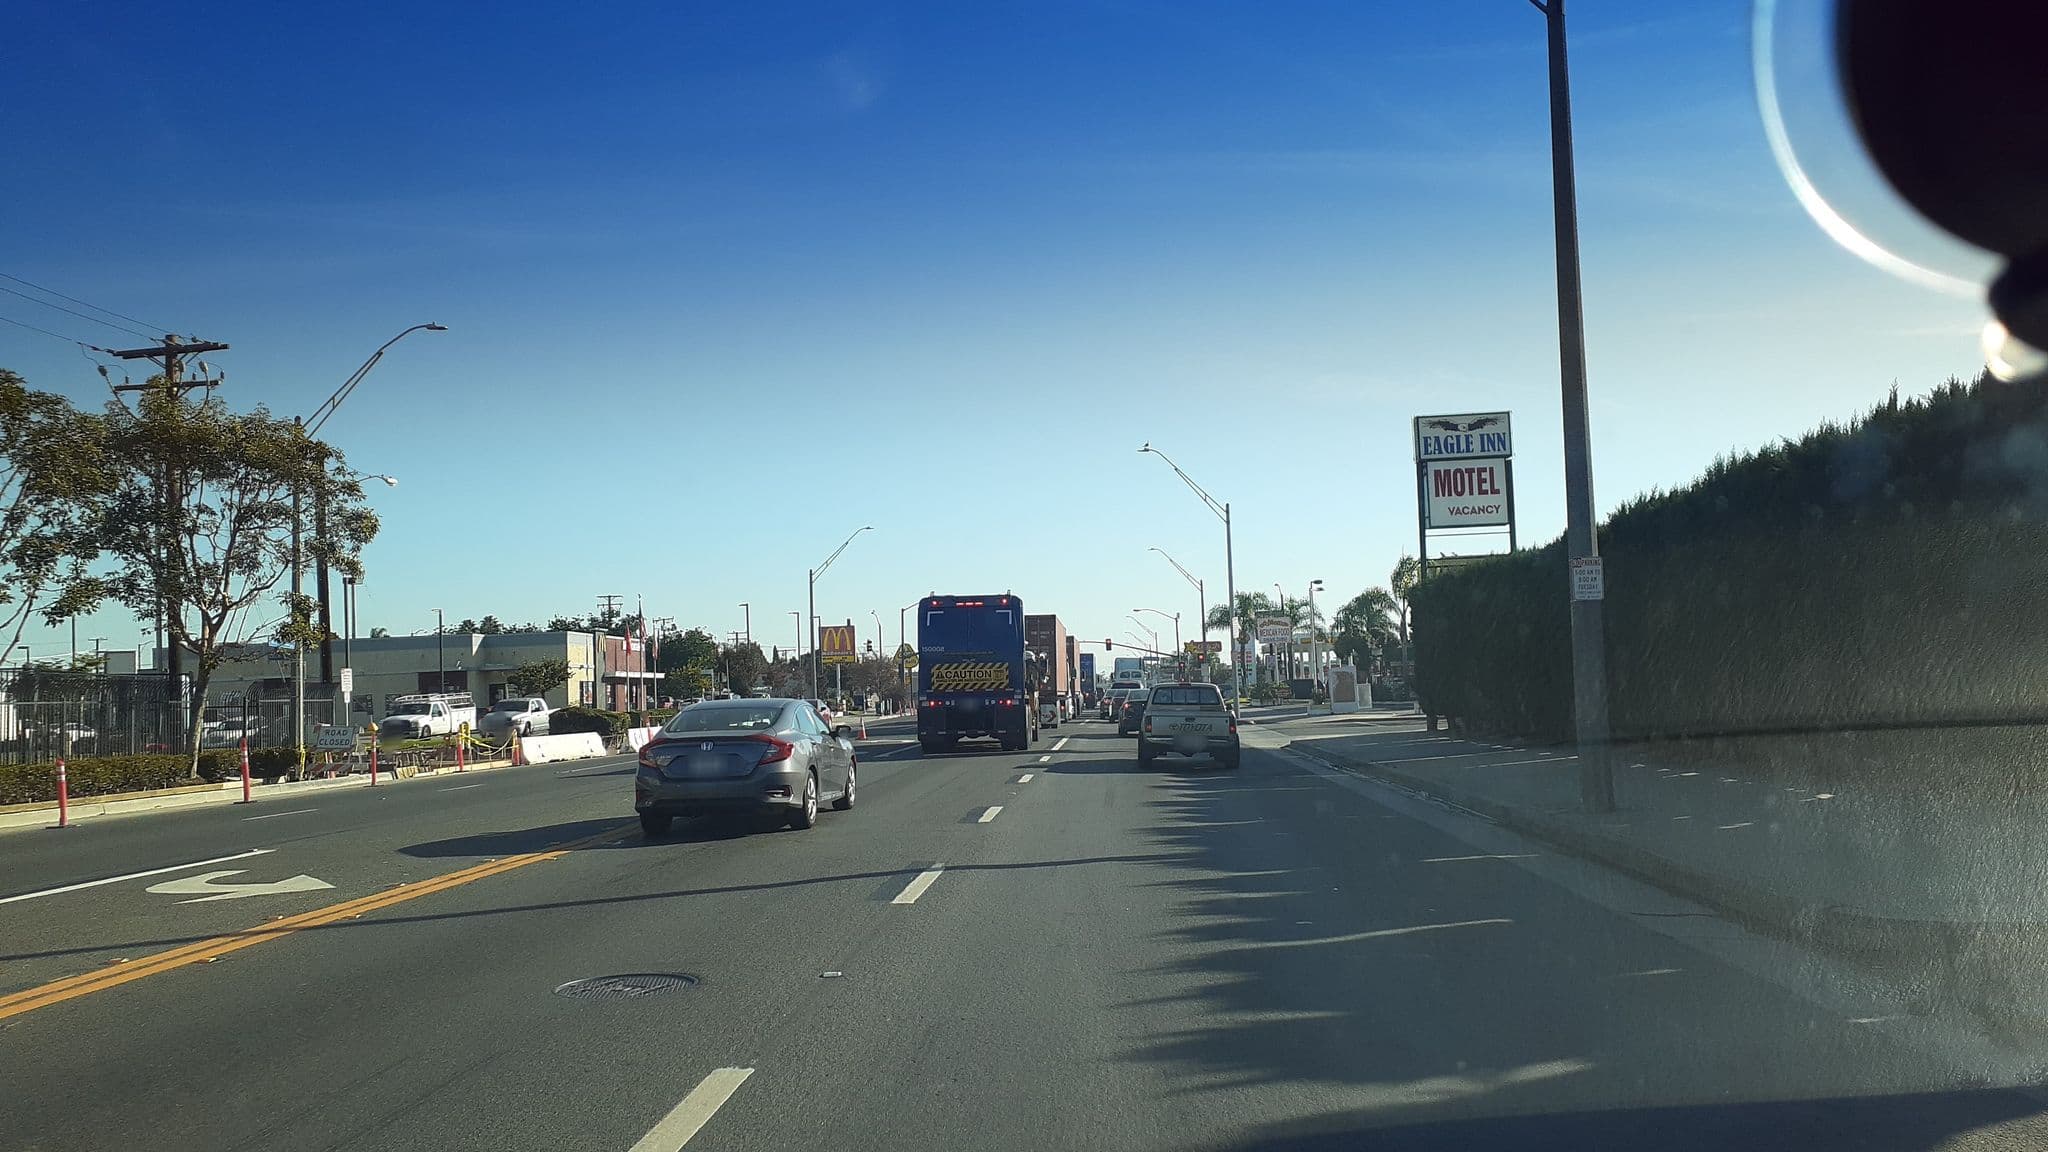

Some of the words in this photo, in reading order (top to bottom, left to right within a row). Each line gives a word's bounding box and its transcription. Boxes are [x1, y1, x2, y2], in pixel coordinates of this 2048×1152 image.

[1423, 434, 1474, 456] EAGLE
[1479, 432, 1507, 453] INN
[1434, 466, 1501, 498] MOTEL
[1448, 504, 1501, 516] VACANCY
[945, 670, 992, 679] CAUTION
[1180, 723, 1213, 732] TOYOTA
[325, 729, 349, 737] ROAD
[318, 738, 350, 746] CLOSED
